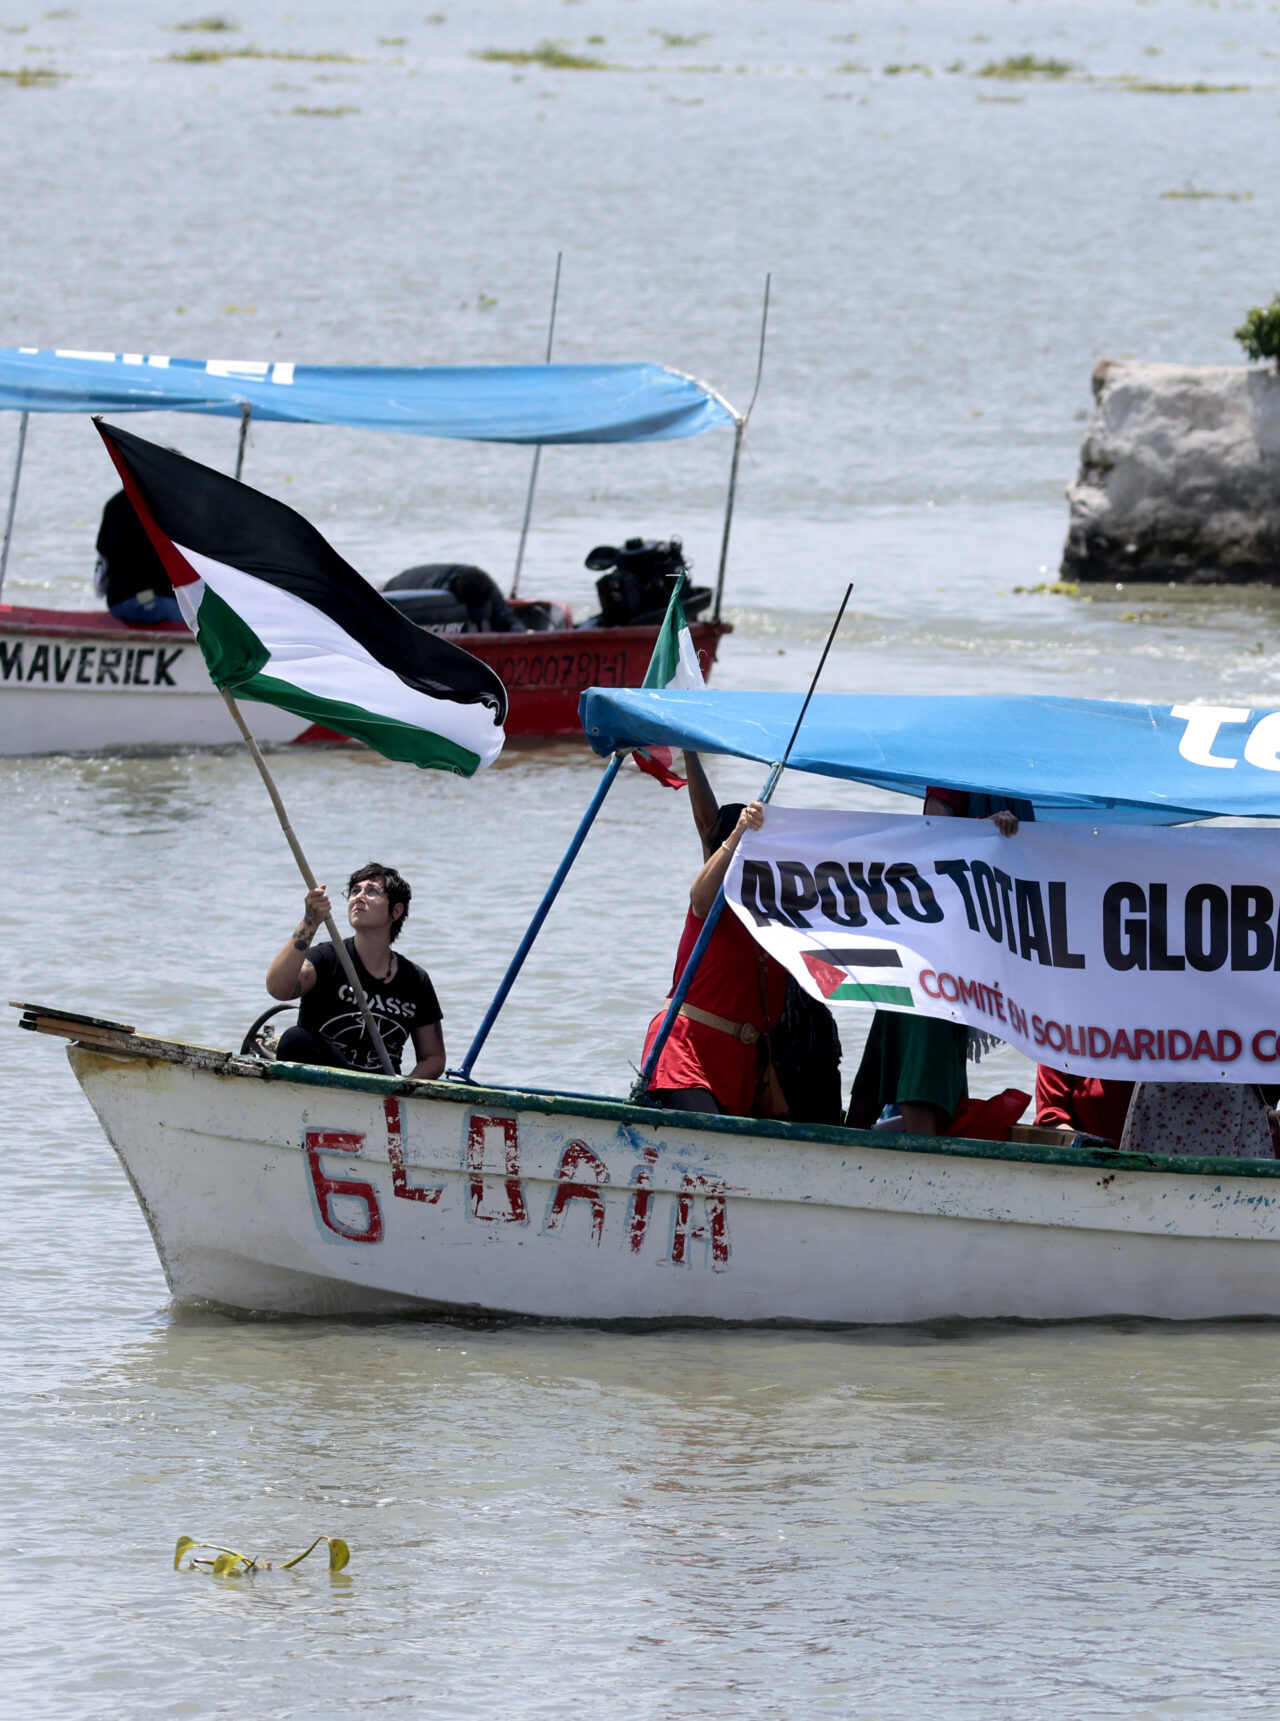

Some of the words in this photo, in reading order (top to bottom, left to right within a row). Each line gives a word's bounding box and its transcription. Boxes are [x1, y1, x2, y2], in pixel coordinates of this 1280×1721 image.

[0, 641, 184, 687] MAVERICK
[740, 859, 946, 929] APOYO
[934, 858, 1086, 970] TOTAL
[918, 968, 1008, 1023] COMITÉ
[1007, 996, 1030, 1040] EN
[1031, 1013, 1243, 1063] SOLIDARIDAD
